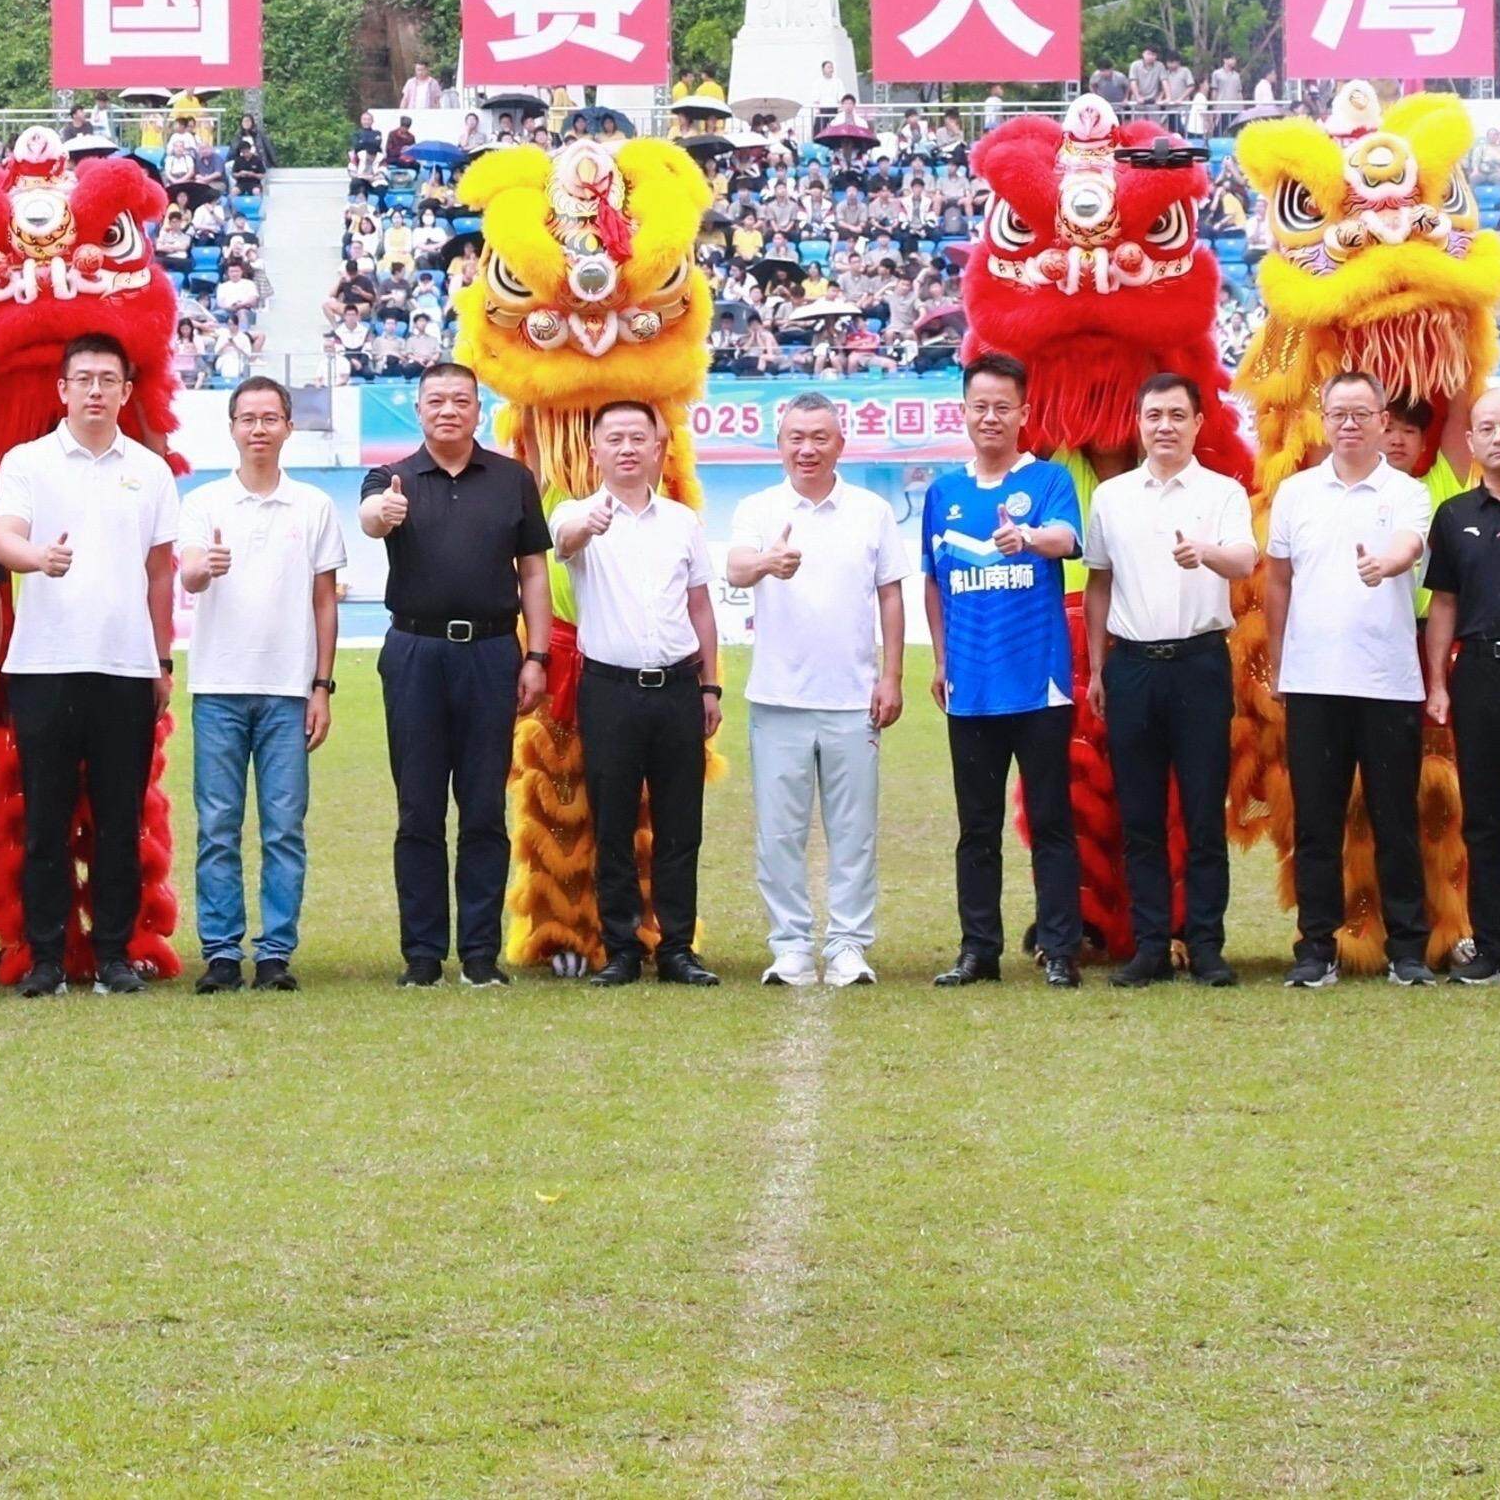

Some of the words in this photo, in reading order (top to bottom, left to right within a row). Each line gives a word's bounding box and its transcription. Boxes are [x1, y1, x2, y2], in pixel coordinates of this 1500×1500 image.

[691, 406, 759, 435] 025
[777, 402, 964, 435] 全国赛
